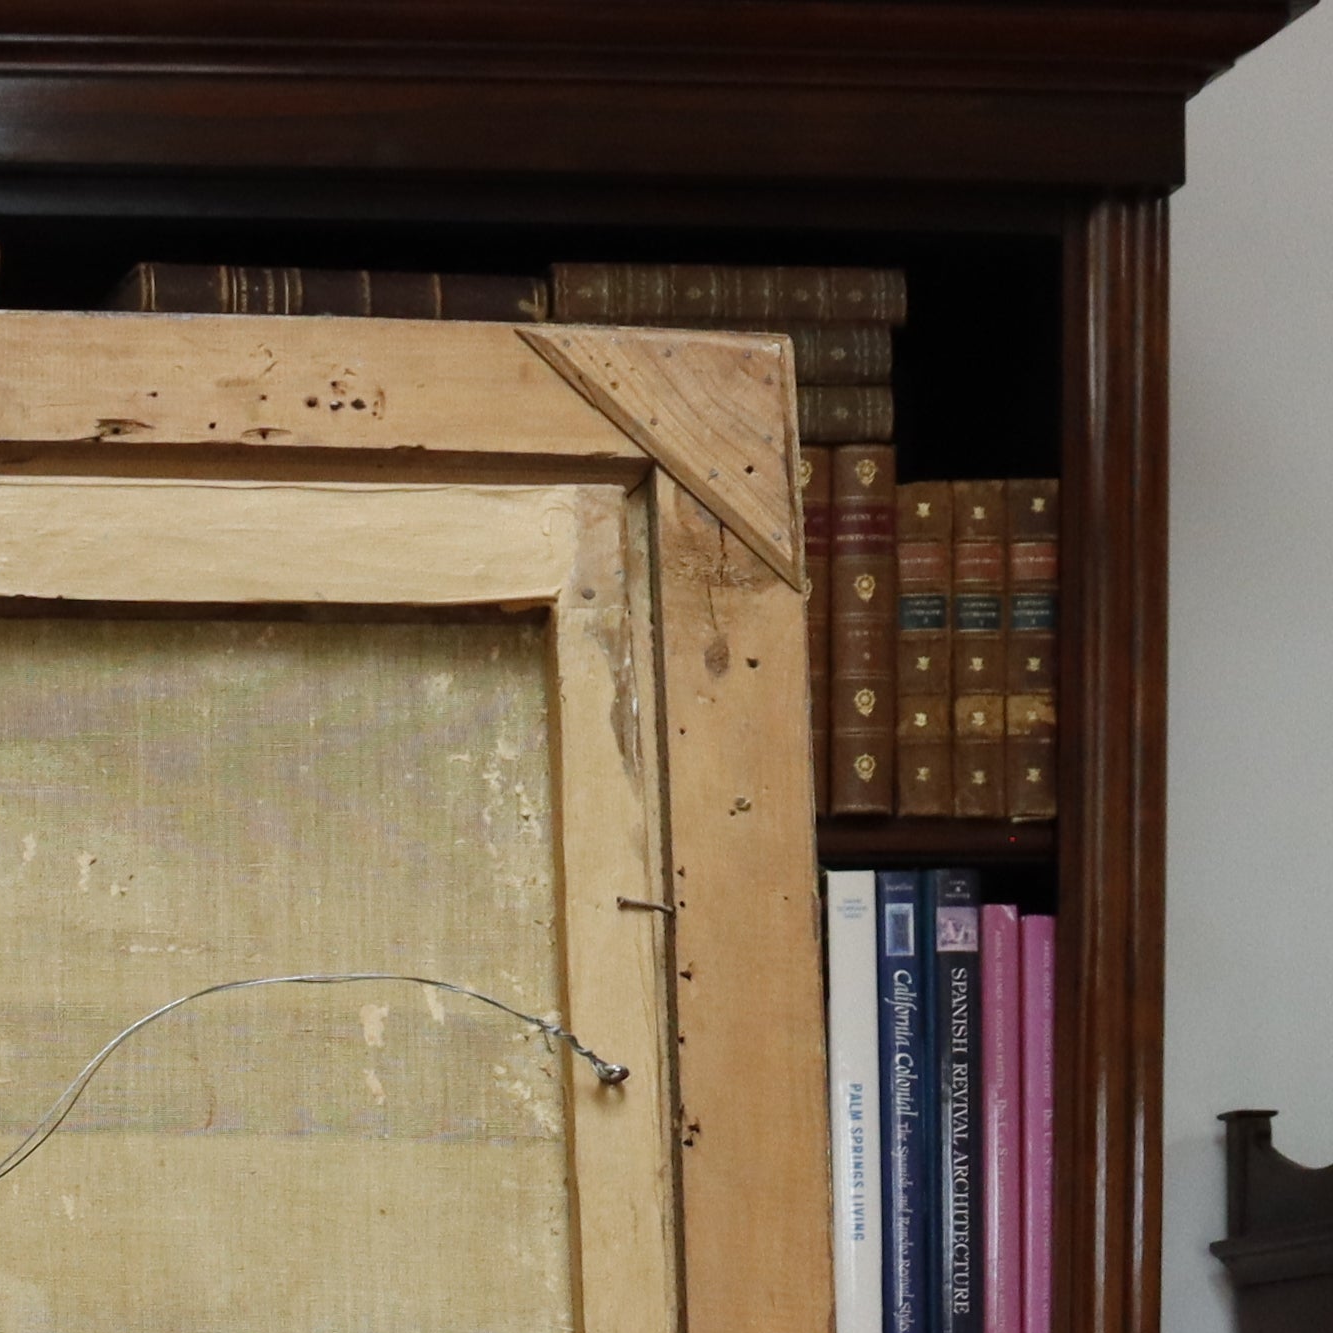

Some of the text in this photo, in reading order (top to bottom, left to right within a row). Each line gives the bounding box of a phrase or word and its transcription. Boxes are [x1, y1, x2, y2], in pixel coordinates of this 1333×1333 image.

[884, 969, 917, 1047] California
[894, 1053, 919, 1117] Colonial
[850, 1083, 866, 1241] PALM SPRINGS LIVING
[896, 1121, 913, 1143] The
[950, 968, 971, 1315] SPANISH REVIVAL ARCHITECTURE
[891, 1146, 913, 1186] Spanish
[898, 1260, 915, 1298] Revival
